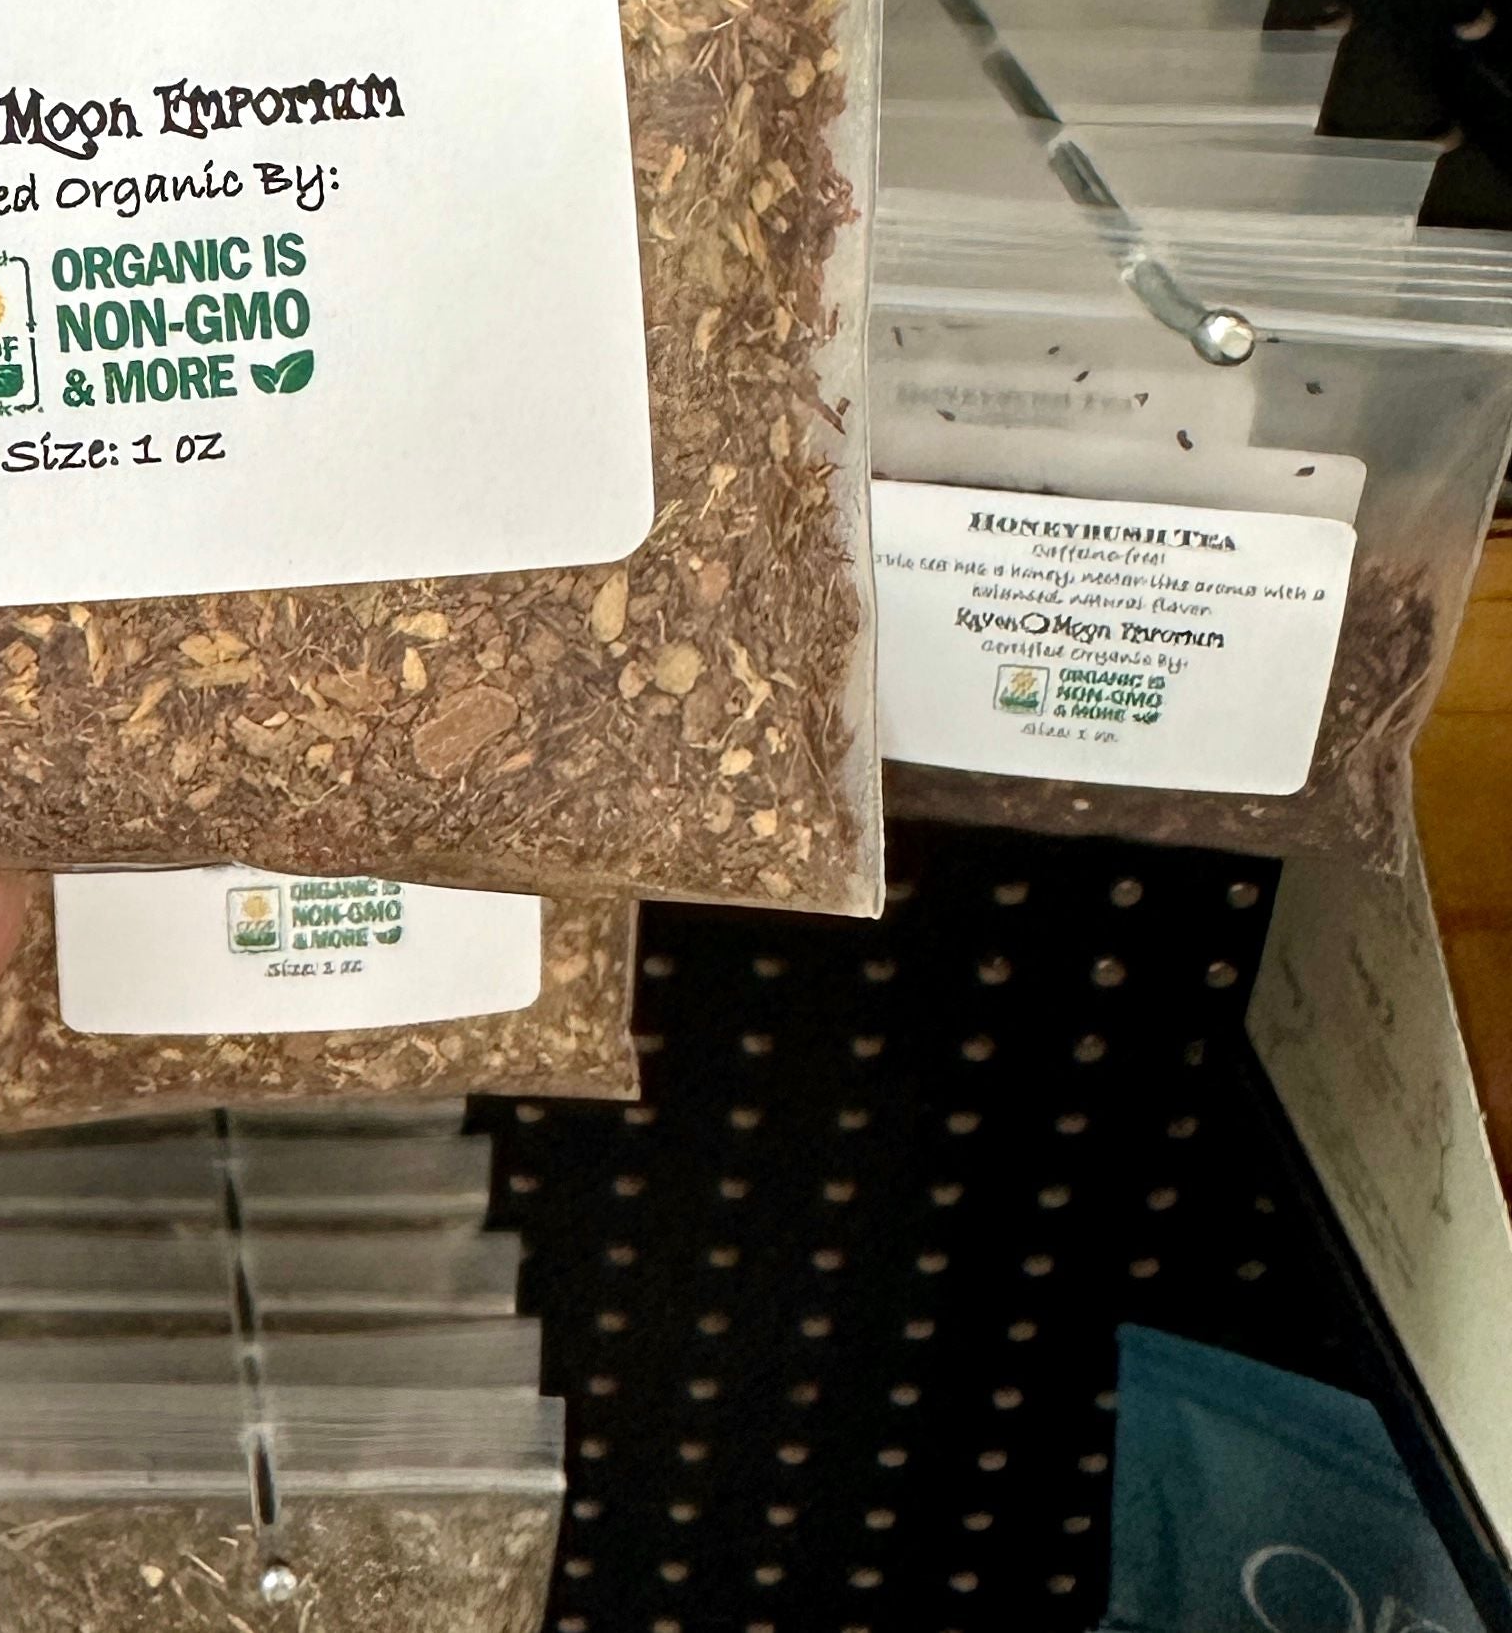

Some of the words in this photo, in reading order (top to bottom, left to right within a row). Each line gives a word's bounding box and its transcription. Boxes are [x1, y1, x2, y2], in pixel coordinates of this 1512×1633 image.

[153, 73, 405, 139] Emporium
[55, 160, 244, 218] Organic
[253, 162, 340, 212] By:
[51, 236, 252, 292] ORGANIC
[263, 232, 307, 277] IS
[56, 288, 311, 353] NON-GMO
[62, 368, 96, 408] &
[102, 354, 238, 404] MORE
[1, 431, 120, 473] Size:
[132, 434, 163, 464] 1
[175, 432, 226, 464] oz
